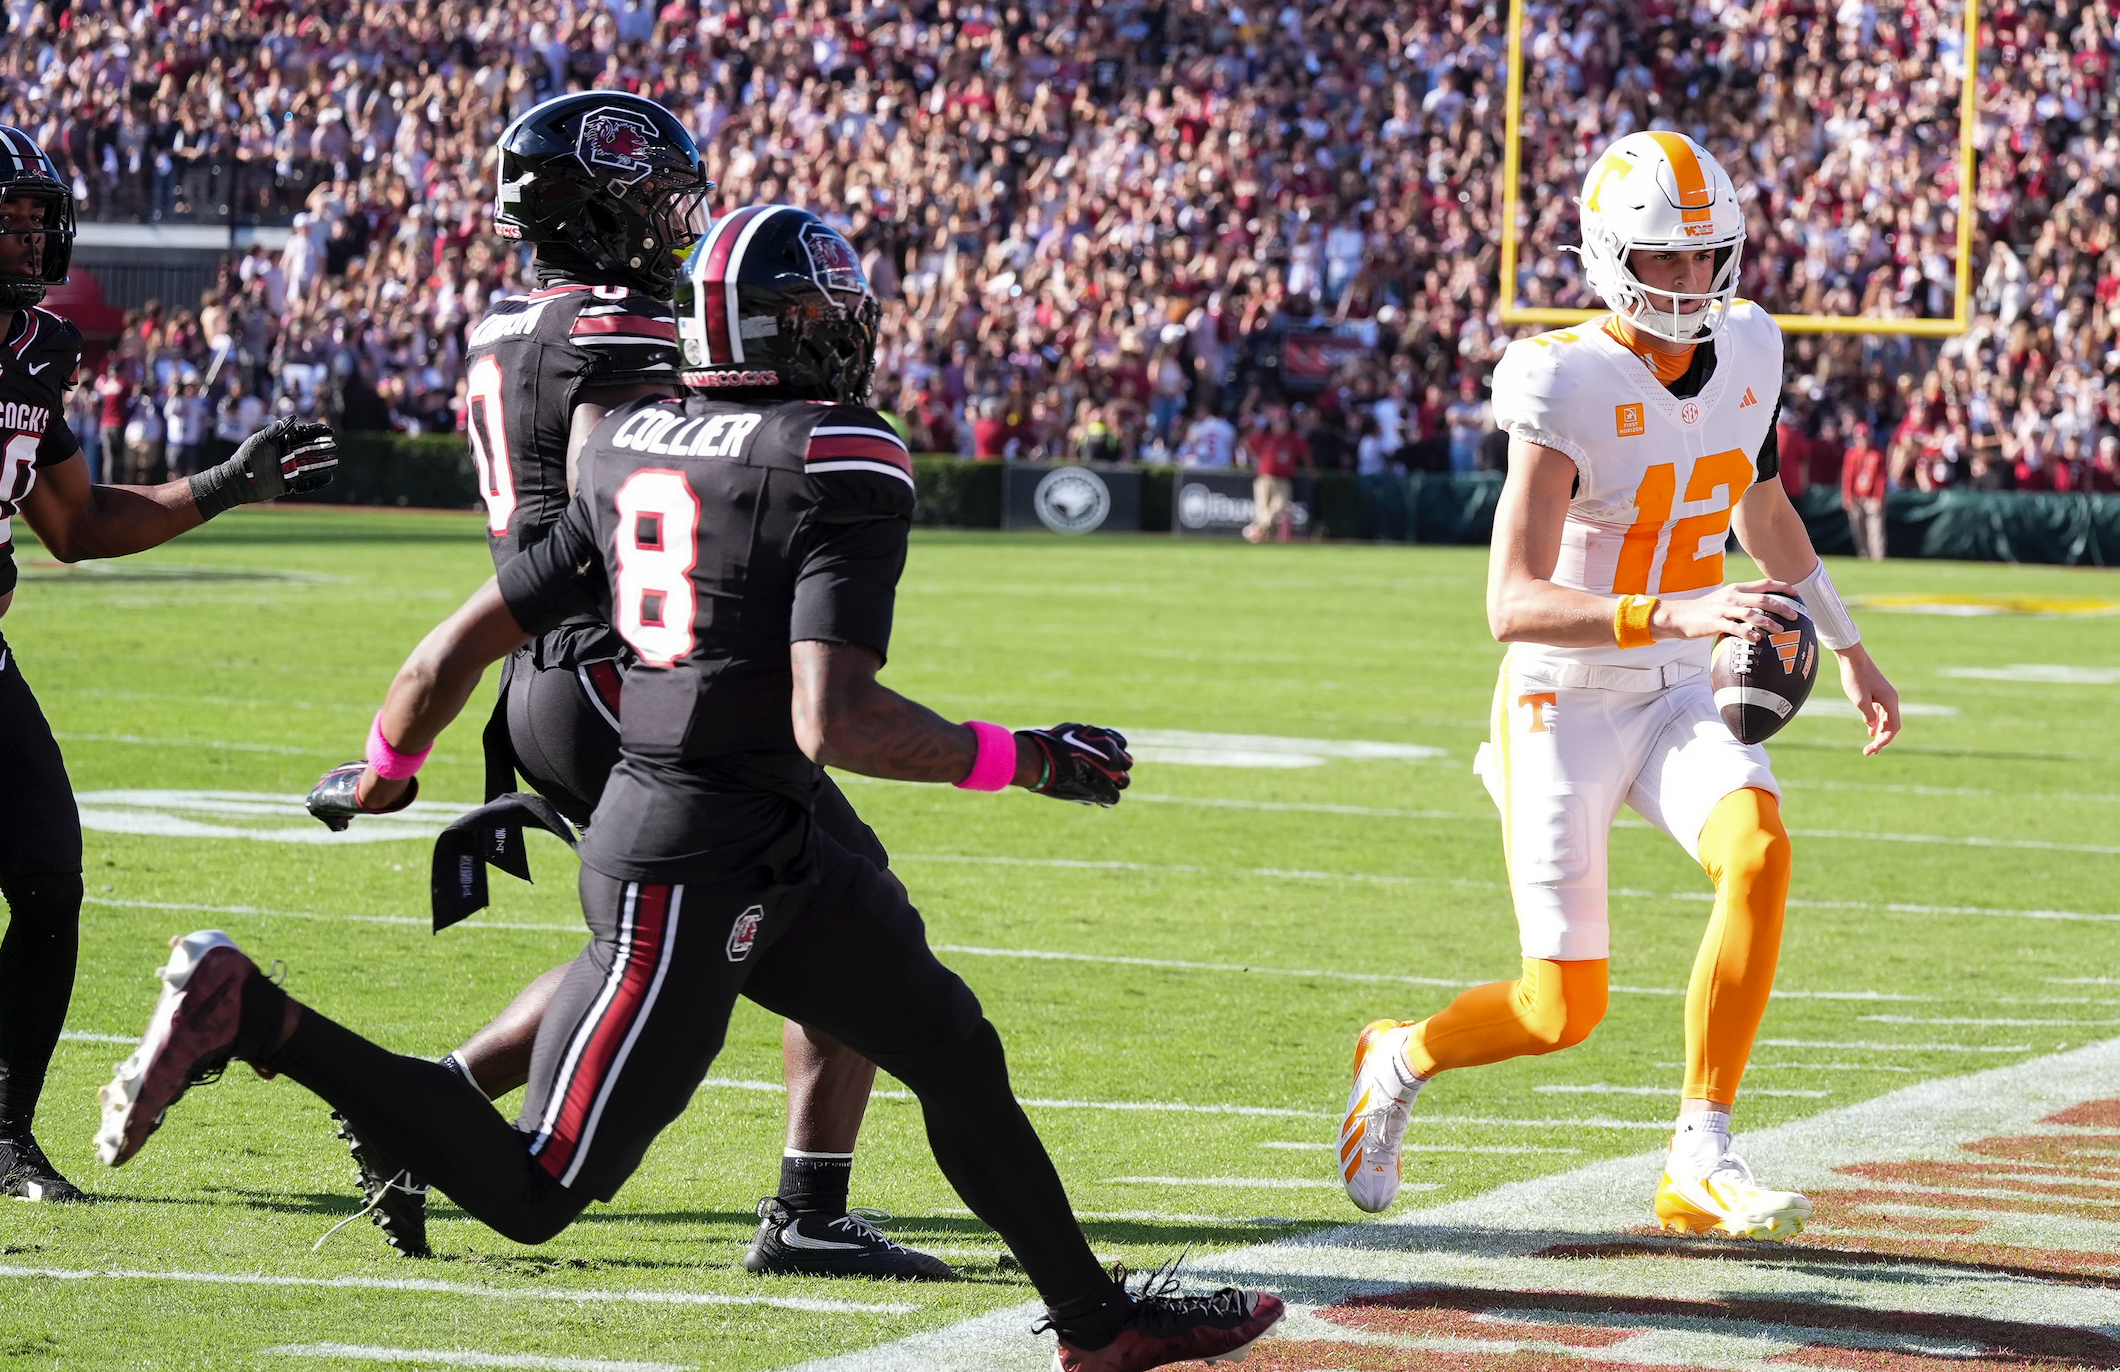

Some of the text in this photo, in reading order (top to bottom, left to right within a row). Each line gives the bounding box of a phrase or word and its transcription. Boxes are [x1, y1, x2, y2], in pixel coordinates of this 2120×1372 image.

[1587, 154, 1634, 213] T
[612, 408, 762, 458] COLLIER
[1619, 426, 1643, 434] HORIZON
[1682, 403, 1699, 424] SEC
[466, 353, 517, 537] 0
[1612, 448, 1754, 594] 12
[614, 467, 701, 668] 8
[1518, 692, 1557, 733] T
